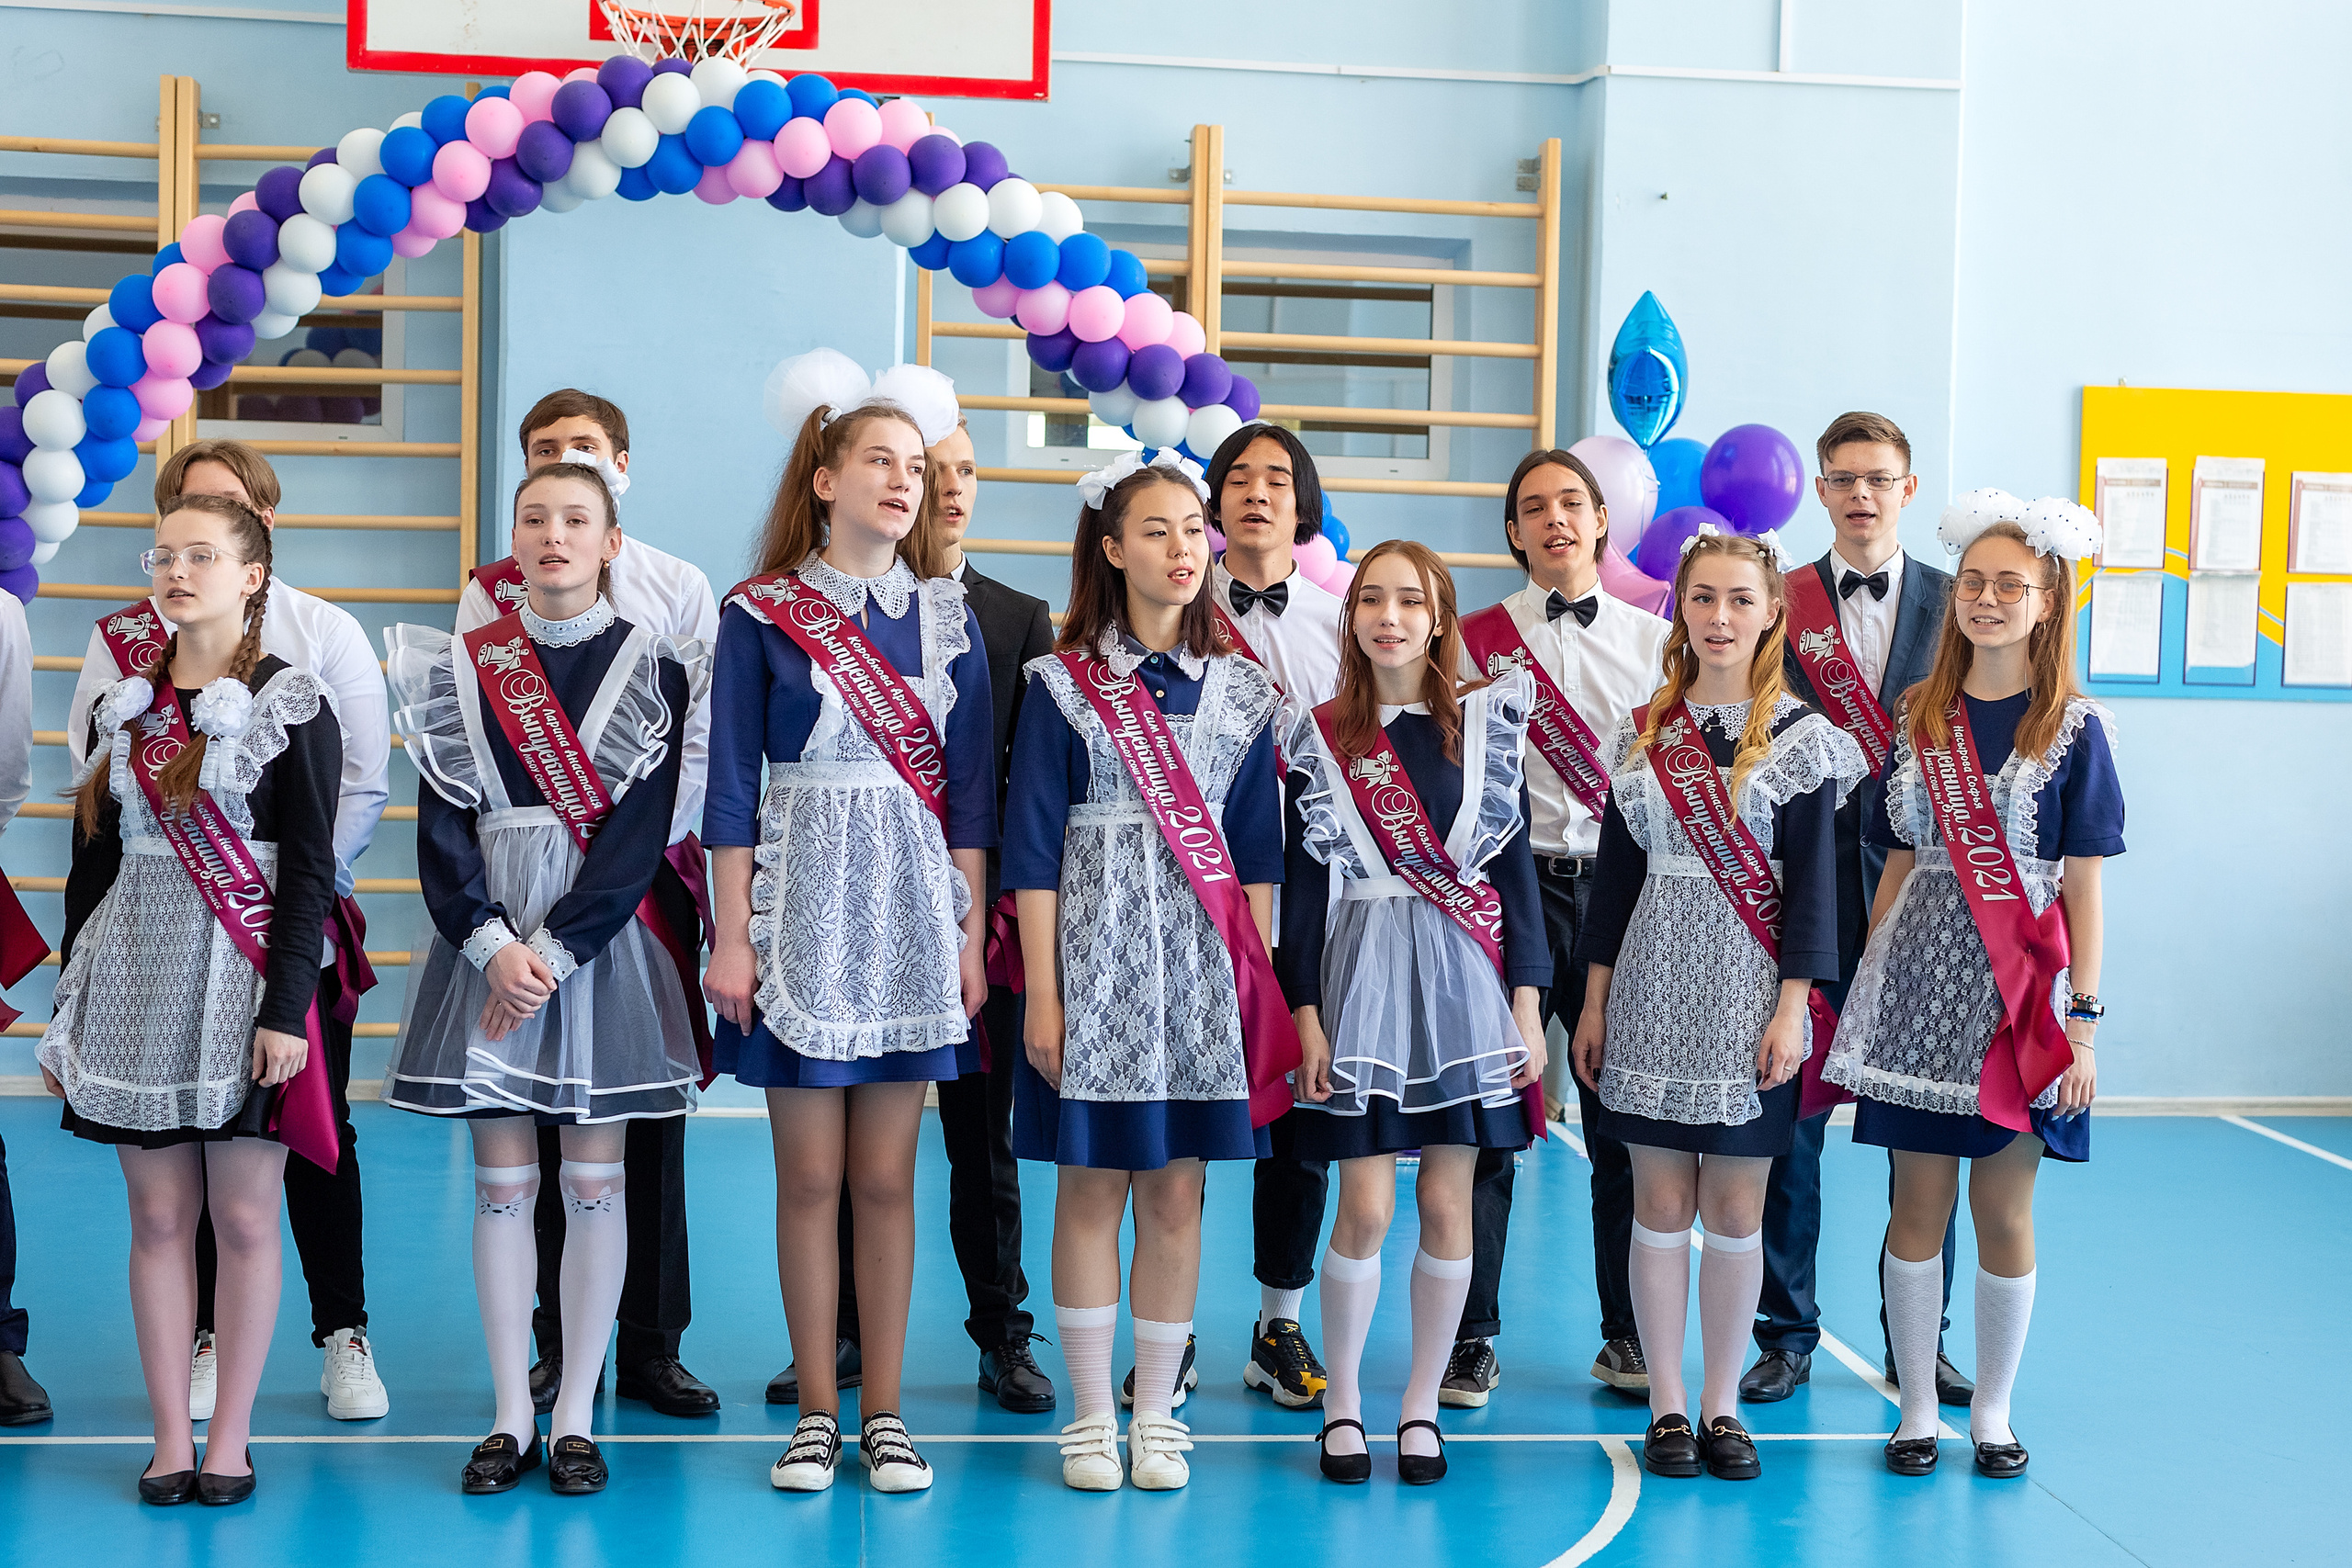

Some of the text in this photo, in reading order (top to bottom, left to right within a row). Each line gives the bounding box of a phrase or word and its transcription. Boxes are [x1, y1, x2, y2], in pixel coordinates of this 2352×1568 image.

[789, 598, 947, 798] Выпускница 2021
[834, 674, 854, 693] МБОУ
[848, 693, 864, 709] СОШ
[847, 636, 919, 720] Коробкова Арина
[1555, 706, 1579, 733] Гудков
[1819, 657, 1887, 766] Выпускни
[1858, 689, 1885, 730] Мордовцев
[500, 669, 588, 820] Выпускница
[1143, 710, 1179, 771] Сим Ирина
[1529, 680, 1603, 789] Выпускник
[523, 753, 540, 773] МБОУ
[534, 773, 548, 790] СОШ
[542, 708, 570, 748] Ларина
[564, 749, 603, 809] Анастасия
[1088, 660, 1232, 883] Выпускница 2021
[1117, 739, 1134, 759] МБОУ
[1128, 759, 1141, 776] СОШ
[1550, 752, 1566, 768] МБОУ
[1563, 768, 1577, 782] СОШ
[1924, 757, 1935, 774] МБОУ
[1953, 726, 1984, 809] Насырова Софья
[1929, 775, 1939, 791] СОШ
[164, 822, 183, 841] МБОУ
[177, 842, 192, 859] СОШ
[218, 837, 253, 881] Наталья
[1414, 824, 1443, 864] Козлова
[1665, 745, 1782, 941] Выпускница 202
[1688, 825, 1702, 844] МБОУ
[1699, 844, 1712, 860] СОШ
[1372, 784, 1475, 911] Выпускница
[1470, 901, 1504, 953] 20
[1399, 866, 1419, 882] МБОУ
[1415, 882, 1432, 895] СОШ
[1740, 849, 1766, 877] Дарья
[1958, 825, 2019, 901] 2021
[222, 884, 275, 948] 202
